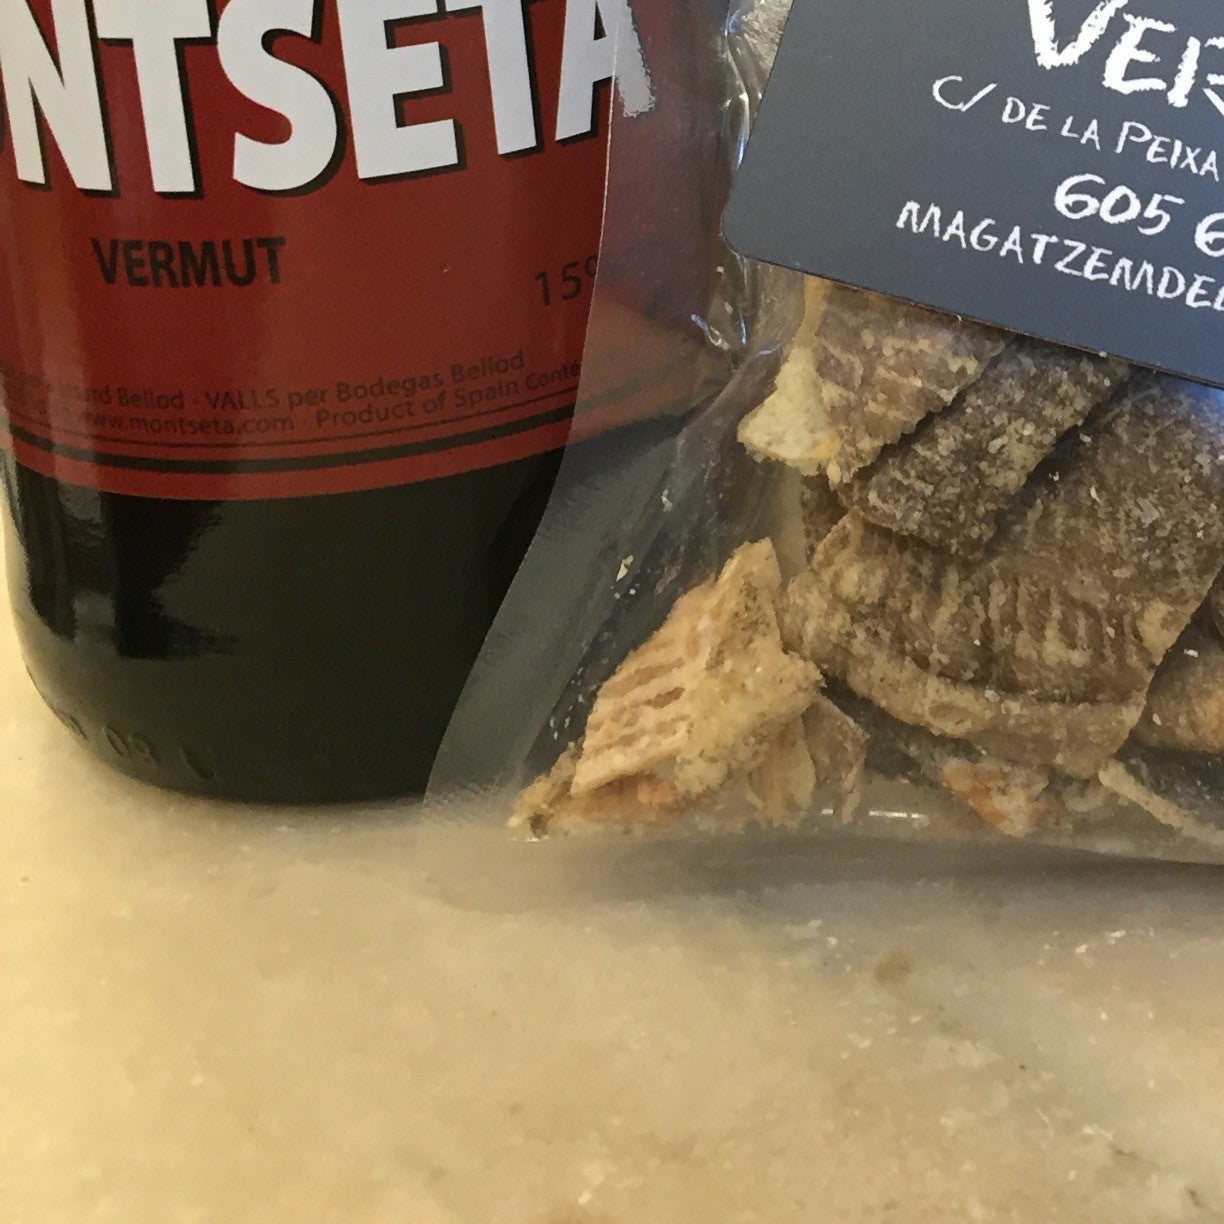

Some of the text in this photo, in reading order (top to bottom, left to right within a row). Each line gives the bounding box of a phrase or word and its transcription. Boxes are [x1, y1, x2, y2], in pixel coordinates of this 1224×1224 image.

[931, 75, 998, 112] C/
[1001, 96, 1051, 131] DE
[1060, 115, 1101, 151] LA
[1053, 173, 1185, 237] 605
[91, 236, 288, 288] VERMUT
[422, 389, 448, 415] of
